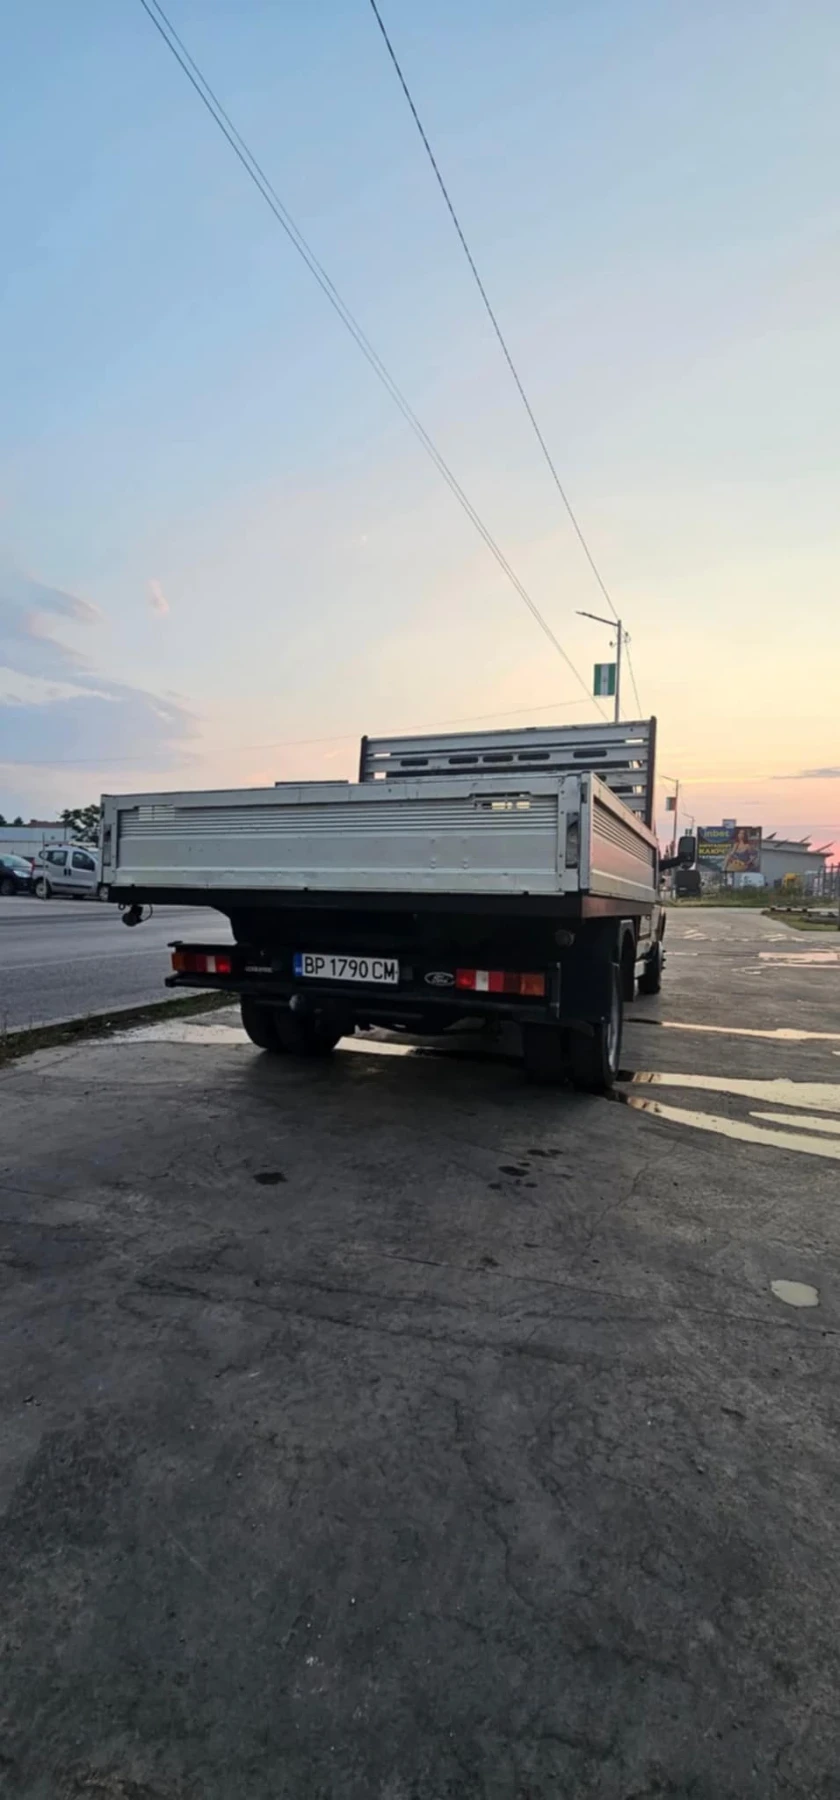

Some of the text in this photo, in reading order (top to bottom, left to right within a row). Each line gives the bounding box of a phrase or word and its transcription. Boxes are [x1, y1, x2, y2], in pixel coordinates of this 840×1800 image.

[304, 956, 395, 981] BP 1790 CM
